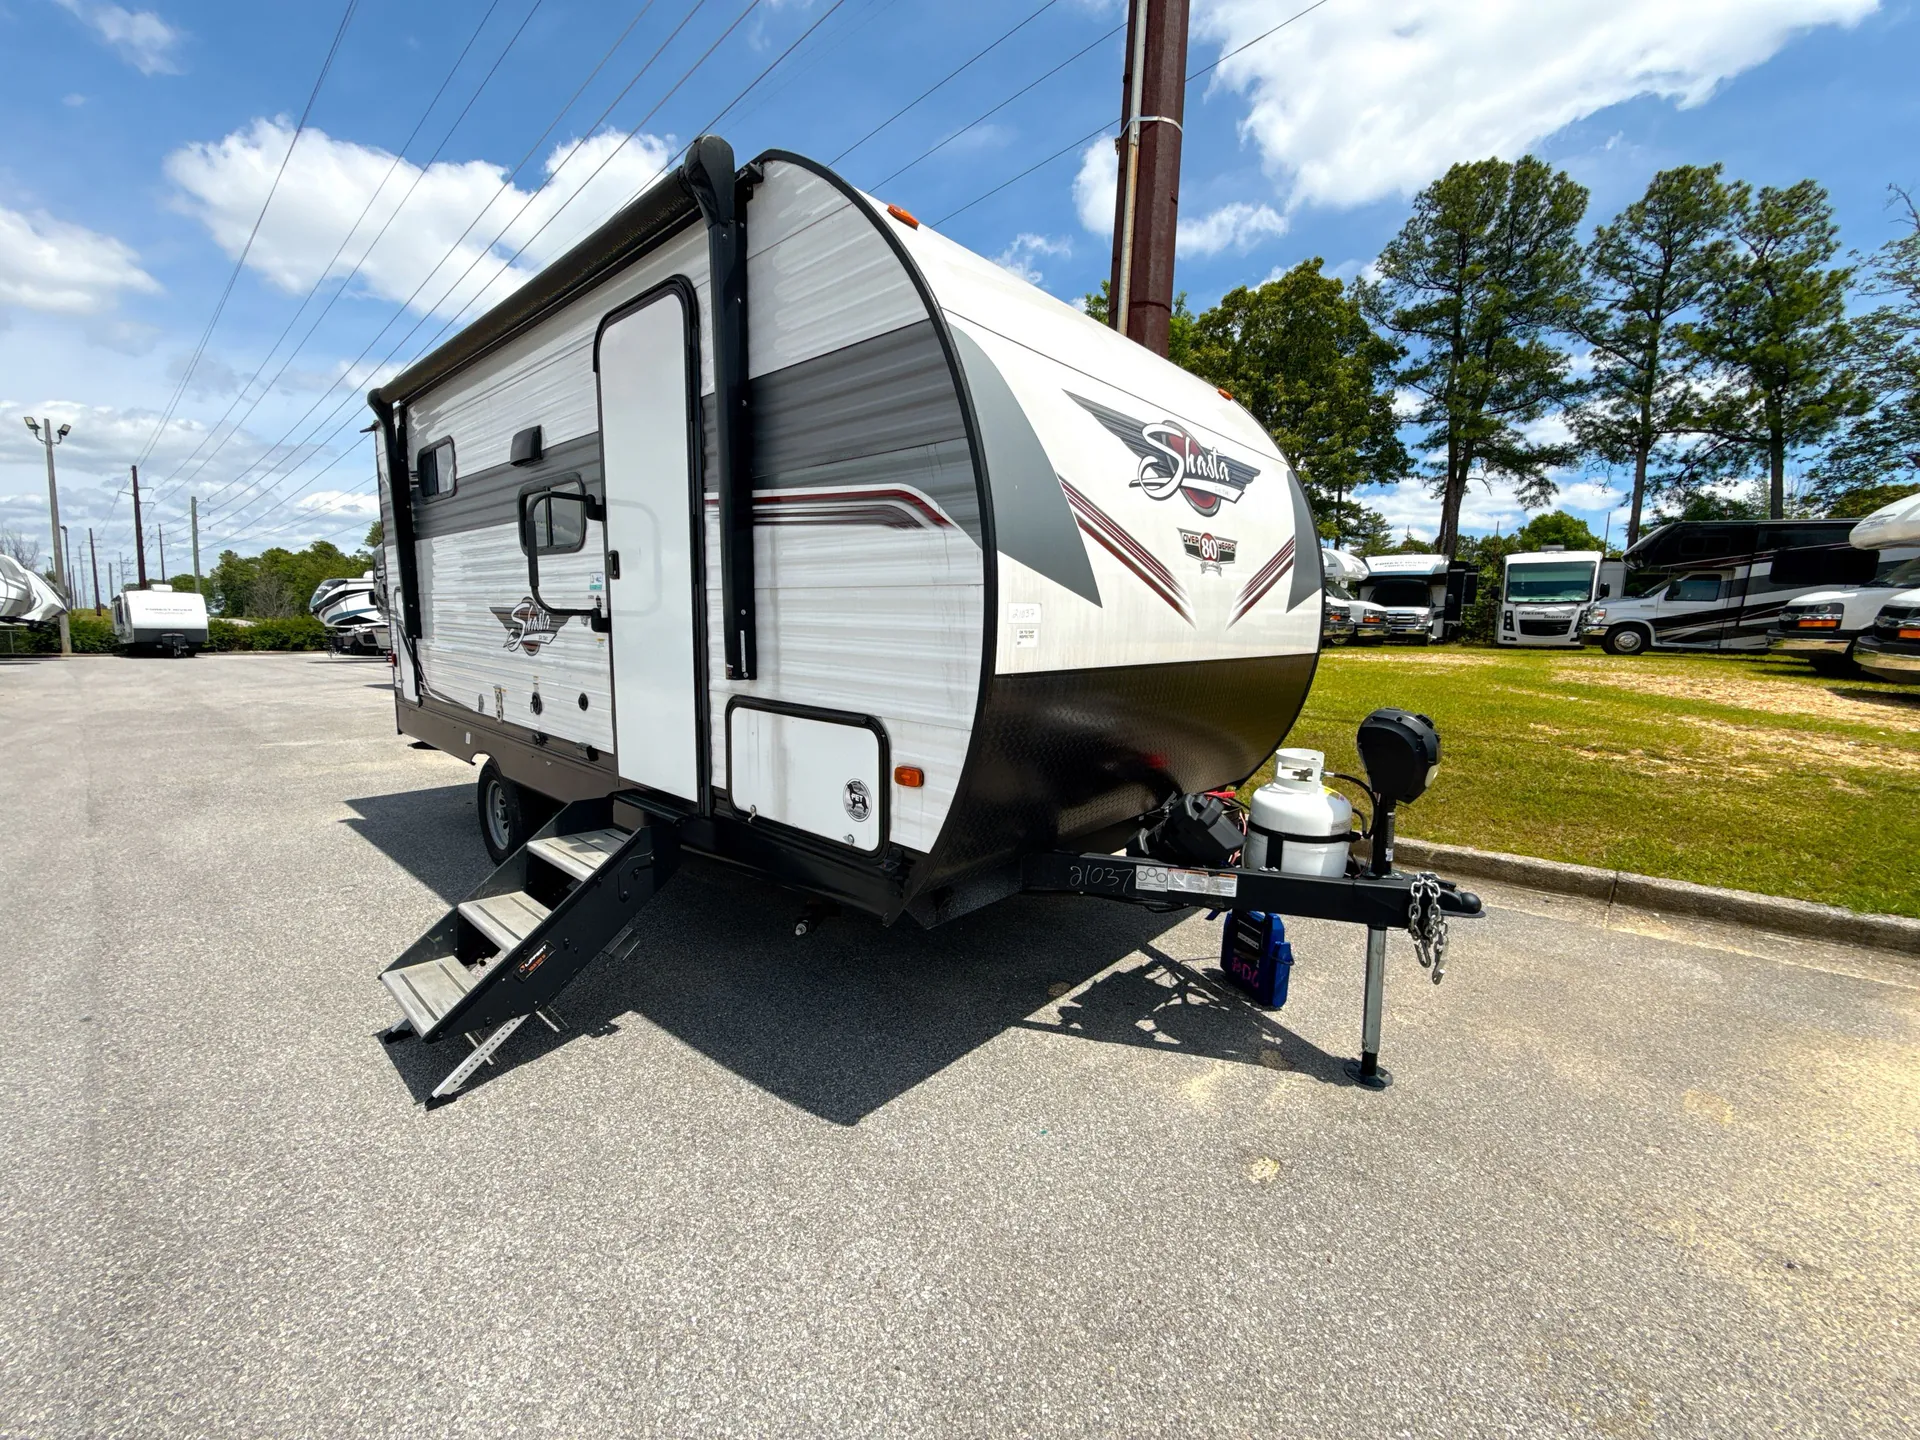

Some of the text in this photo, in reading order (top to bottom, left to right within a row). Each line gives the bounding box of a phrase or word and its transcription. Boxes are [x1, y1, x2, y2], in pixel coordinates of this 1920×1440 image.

[1137, 422, 1230, 501] Shasta
[1183, 533, 1235, 560] OVER 80 YEARS
[506, 602, 551, 652] Shasta
[851, 793, 863, 803] PET
[1069, 865, 1134, 893] 21037
